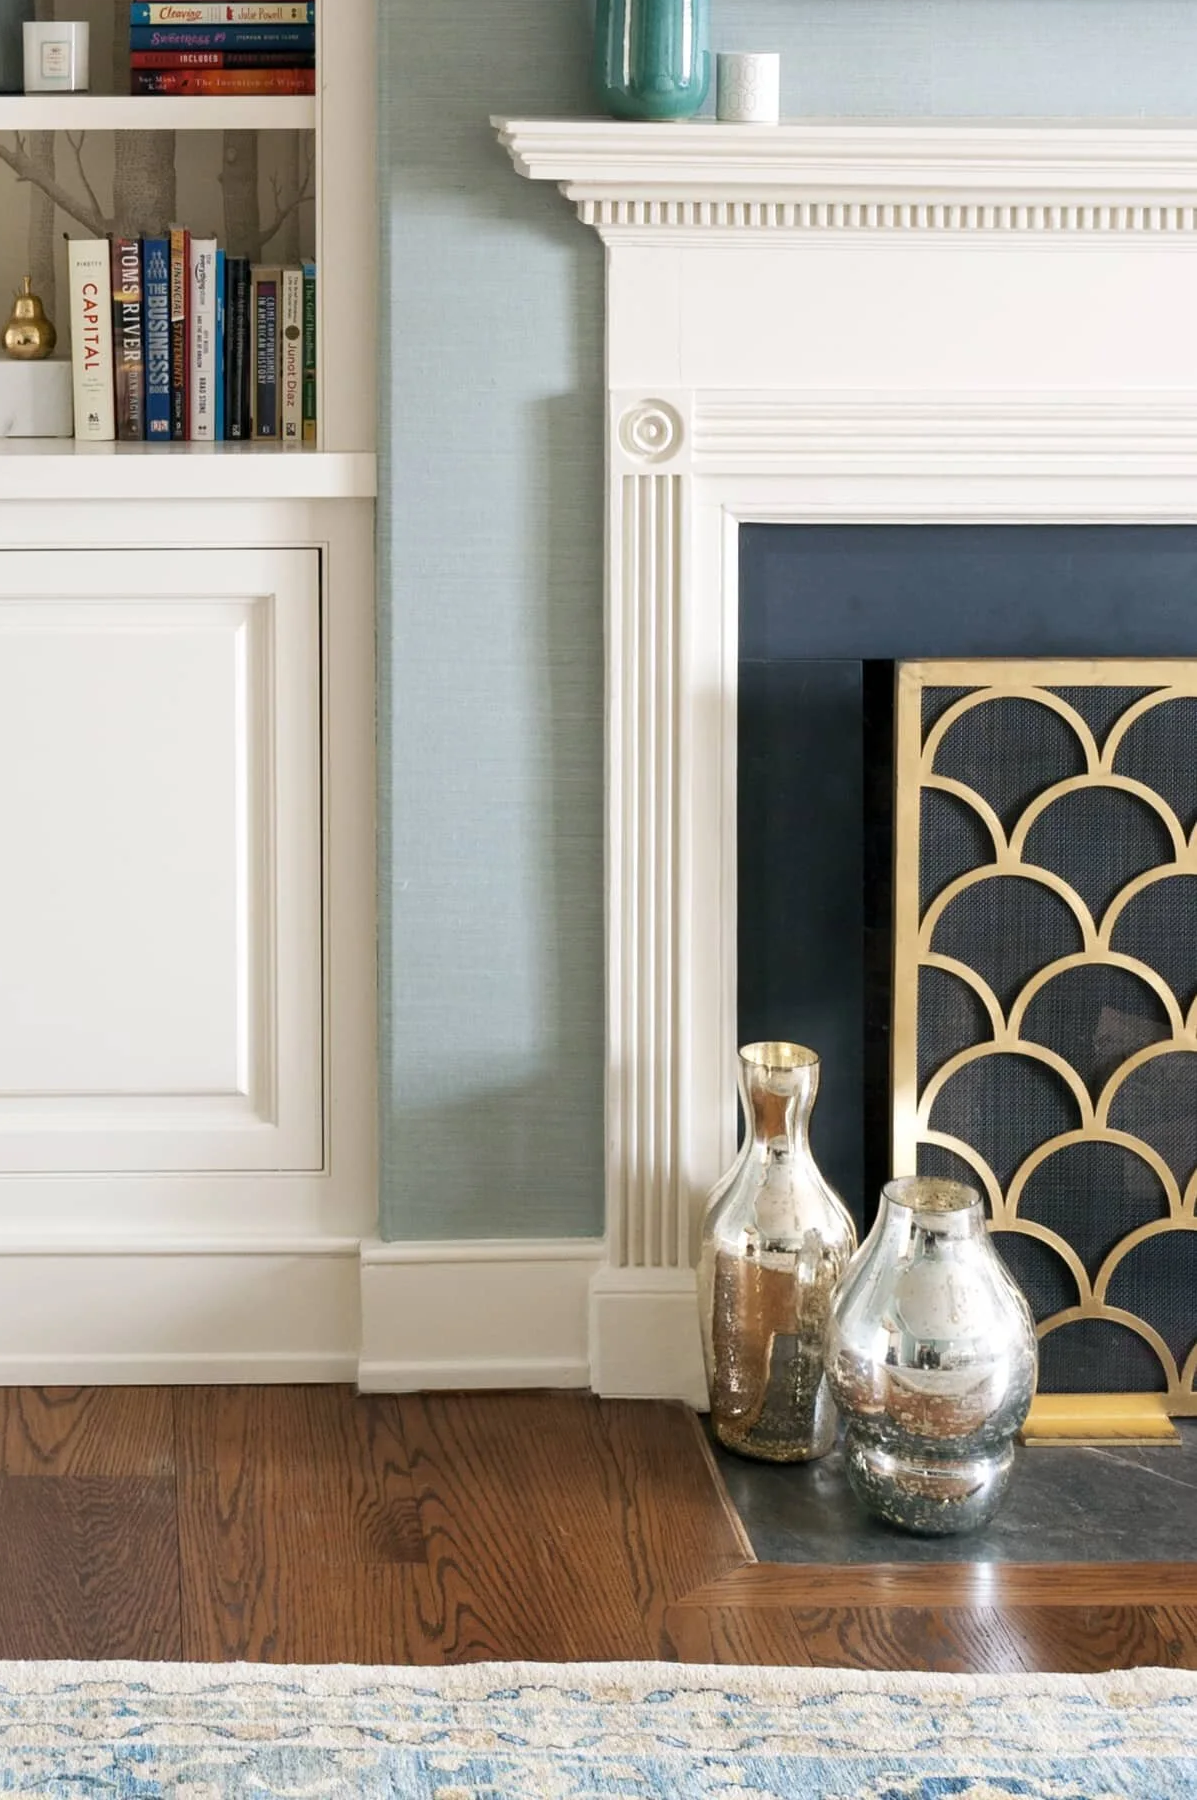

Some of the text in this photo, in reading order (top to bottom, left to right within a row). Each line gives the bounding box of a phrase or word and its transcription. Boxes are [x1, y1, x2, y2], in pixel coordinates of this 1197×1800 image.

[159, 6, 202, 22] Cleaving
[238, 8, 282, 20] Julie Powell
[151, 32, 211, 46] Sweetness
[180, 54, 218, 63] INCLUDED
[196, 78, 212, 86] The
[216, 78, 261, 86] Invention
[264, 78, 274, 86] of
[122, 243, 141, 362] TOMS RIVER
[148, 283, 168, 295] THE
[82, 283, 100, 370] CAPITAL
[148, 296, 170, 385] BUSINESS
[174, 262, 183, 388] FINANCIAL STATEMENTS
[258, 296, 266, 384] IN AMERICAN HISTORY
[306, 284, 314, 366] The Golf Handbook
[267, 337, 275, 384] PUNISHMENT
[287, 343, 298, 407] Junot Díaz
[149, 386, 168, 394] BOOK
[198, 395, 206, 414] STONE
